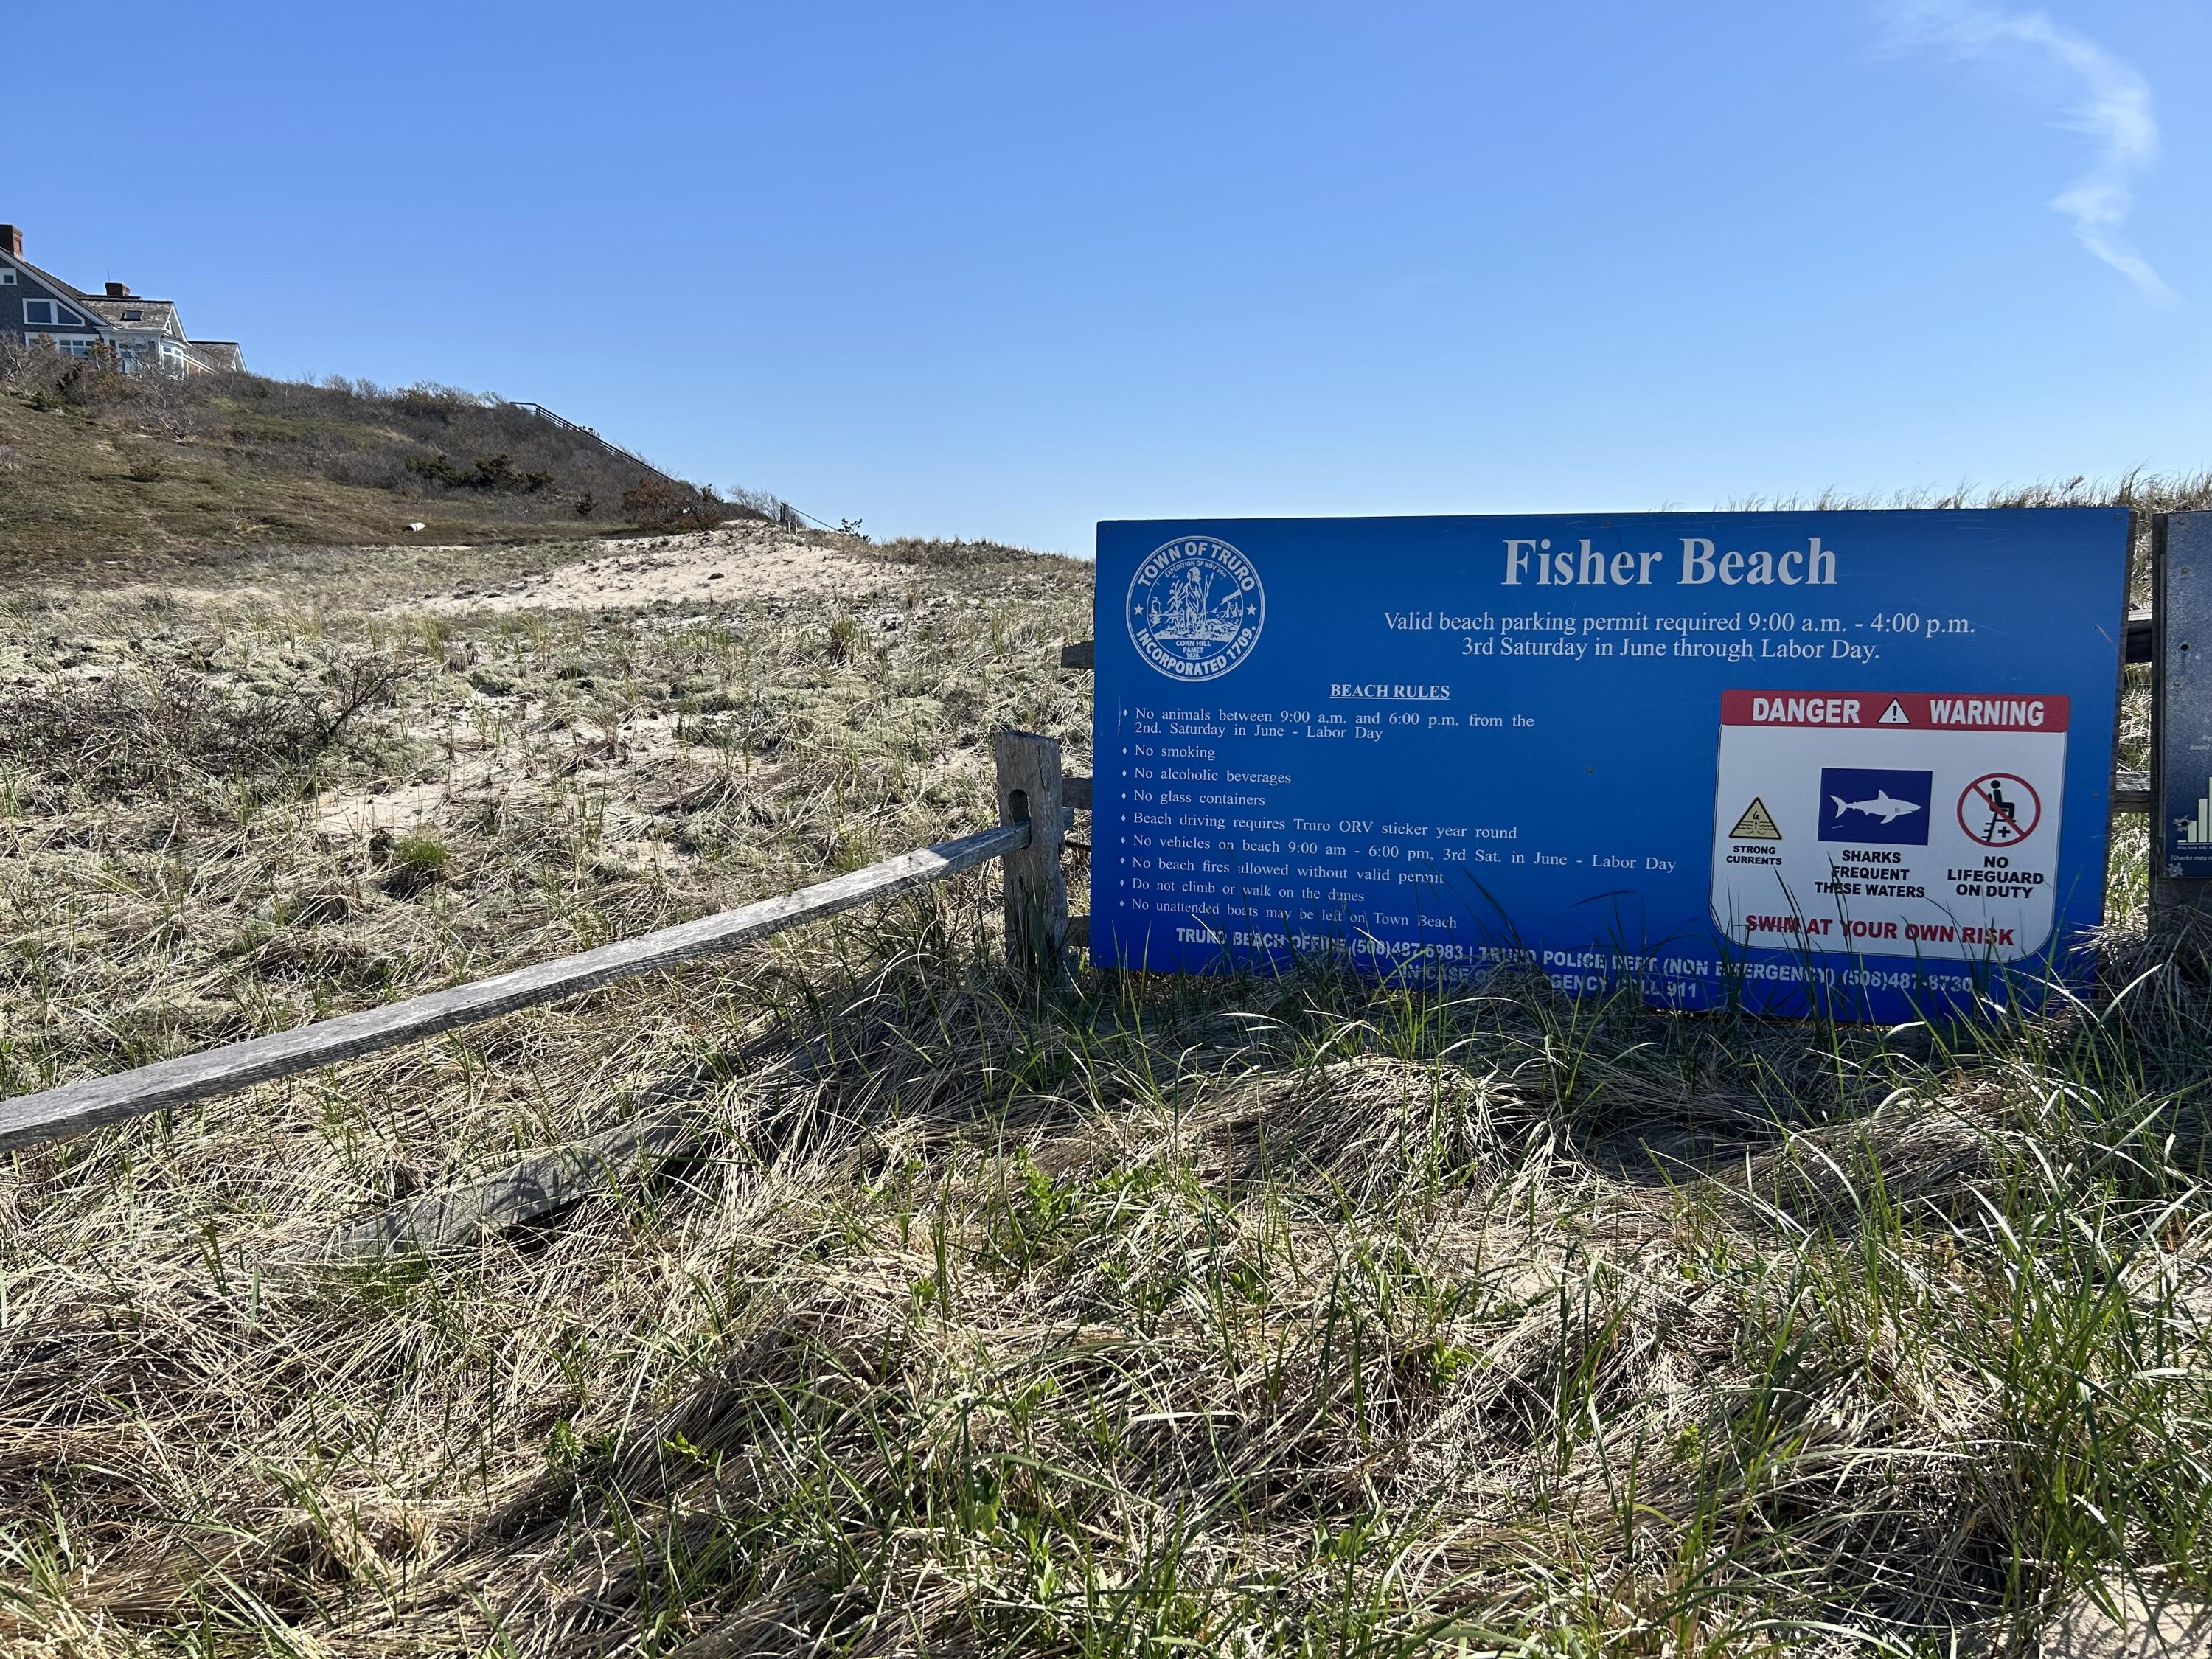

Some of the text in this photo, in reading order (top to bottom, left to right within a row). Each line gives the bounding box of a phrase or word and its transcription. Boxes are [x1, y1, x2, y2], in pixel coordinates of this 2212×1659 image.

[1138, 541, 1255, 591] TOWN OF TRURO
[1165, 560, 1194, 577] EXPEDITION
[1204, 561, 1217, 572] NOV
[1500, 538, 1837, 585] Fisher Beach
[1383, 611, 1433, 630] Valid
[1439, 612, 1495, 630] beach
[1500, 612, 1576, 636] parking
[1582, 612, 1649, 636] permit
[1655, 612, 1741, 636] required
[1748, 613, 1795, 632] 9:00
[1801, 616, 1846, 633] a.m.
[1870, 613, 1919, 633] 4:00
[1925, 618, 1975, 638] p.m.
[1136, 628, 1227, 675] INCORPORATED
[1461, 637, 1880, 664] 3rd Saturday in June through Labor Day.
[1330, 683, 1450, 699] BEACH RULES
[1135, 708, 1534, 728] No animals between 9:00 a.m. and 6:00 p.m. from the
[1752, 698, 2044, 726] DANGER WARNING
[1135, 721, 1161, 734] 2nd.
[1169, 723, 1225, 737] Saturday
[1234, 724, 1246, 736] in
[1254, 725, 1284, 737] June
[1307, 726, 1346, 738] Labor
[1355, 726, 1383, 742] Day
[1135, 745, 1216, 761] No smoking
[1134, 767, 1291, 786] No alcoholic beverages
[1134, 790, 1265, 806] No glass containers
[1133, 813, 1517, 839] Beach driving requires Truro ORV sticker year round
[1133, 835, 1152, 846] No
[1159, 835, 1211, 849] vehicles
[1218, 841, 1234, 850] on
[1242, 839, 1280, 852] beach
[1288, 841, 1318, 854] 9:00
[1326, 846, 1346, 855] am
[1368, 846, 1399, 858] 6:00
[1408, 849, 1434, 861] pm,
[1442, 848, 1466, 861] 3rd
[1475, 849, 1502, 863] Sat.
[1512, 850, 1525, 863] in
[1534, 852, 1568, 866] June
[1592, 855, 1637, 869] Labor
[1646, 857, 1677, 873] Day
[1733, 845, 1776, 855] STRONG
[1842, 850, 1901, 863] SHARKS
[1132, 857, 1444, 885] No beach fires allowed without valid permit
[1726, 856, 1782, 866] CURRENTS
[1983, 856, 2008, 869] NO
[1832, 866, 1910, 880] FREQUENT
[1947, 869, 2044, 885] LIFEGUARD
[1132, 877, 1364, 902] Do not climb or walk on the dunes
[1815, 881, 1925, 898] THESE WATERS
[1956, 884, 2034, 898] ON DUTY
[1132, 898, 1457, 928] No unattended boats may be left on Town Beach
[1745, 914, 2014, 946] SWIM AT YOUR OWN RISK
[1176, 928, 1226, 945] TRURO
[1233, 931, 1284, 949] BEACH
[1543, 950, 1604, 969] POLICE
[1663, 958, 1708, 977] (NON
[1667, 981, 1696, 998] 911
